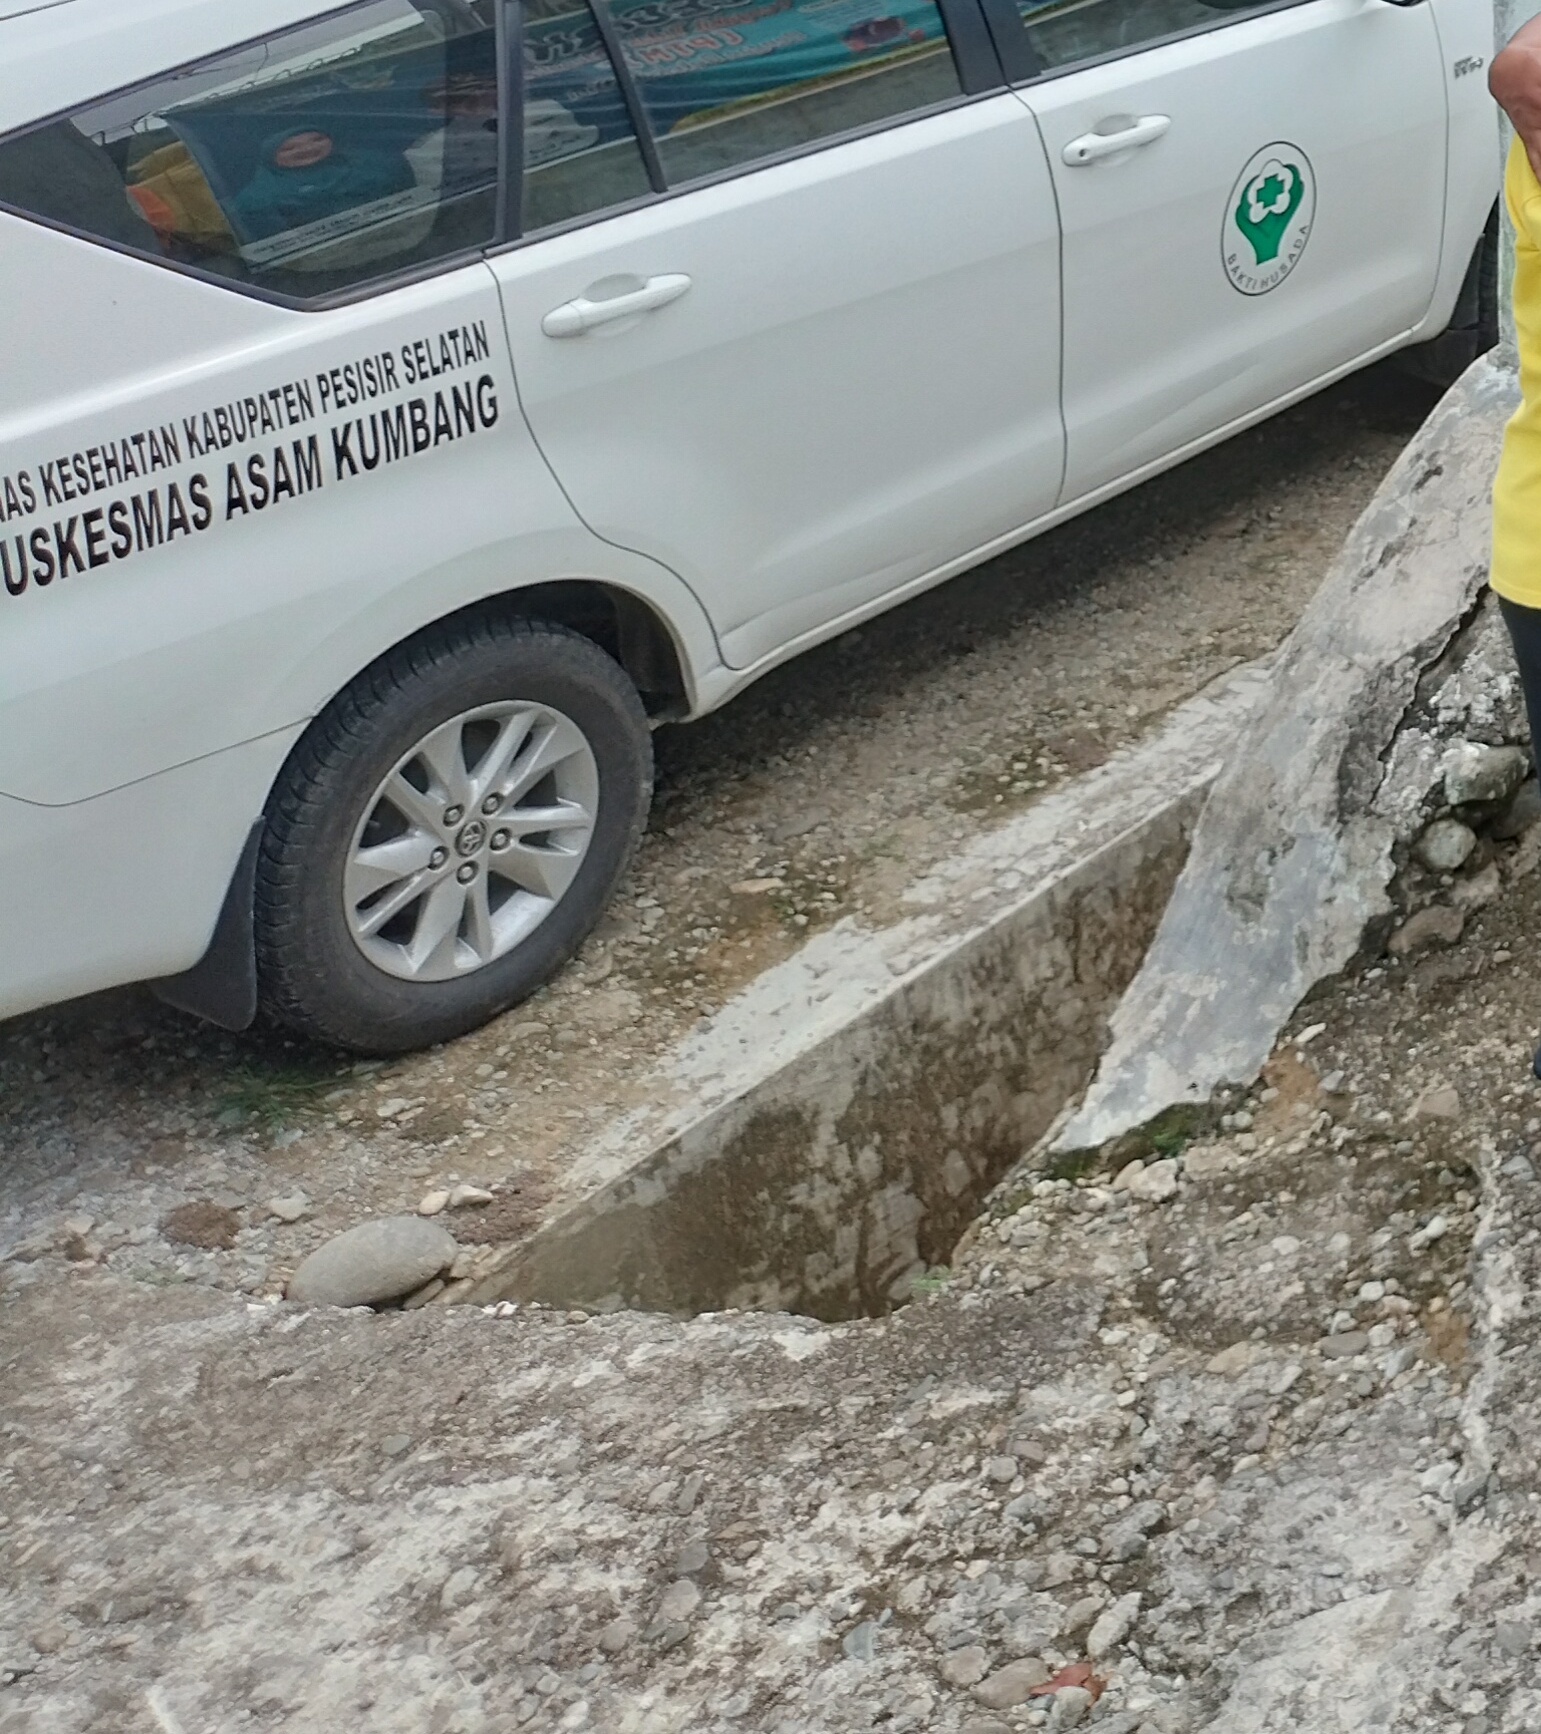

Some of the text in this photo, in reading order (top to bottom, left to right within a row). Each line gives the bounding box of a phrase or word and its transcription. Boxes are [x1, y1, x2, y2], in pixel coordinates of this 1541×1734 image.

[1227, 225, 1310, 291] BAKTI HUSADA
[38, 423, 181, 507] KESEHATAN
[182, 378, 316, 459] KABUPATEN
[315, 351, 401, 415] PESISIR
[401, 320, 491, 384] SELATAN
[225, 434, 324, 522] ASAM
[330, 373, 499, 482] KUMBANG
